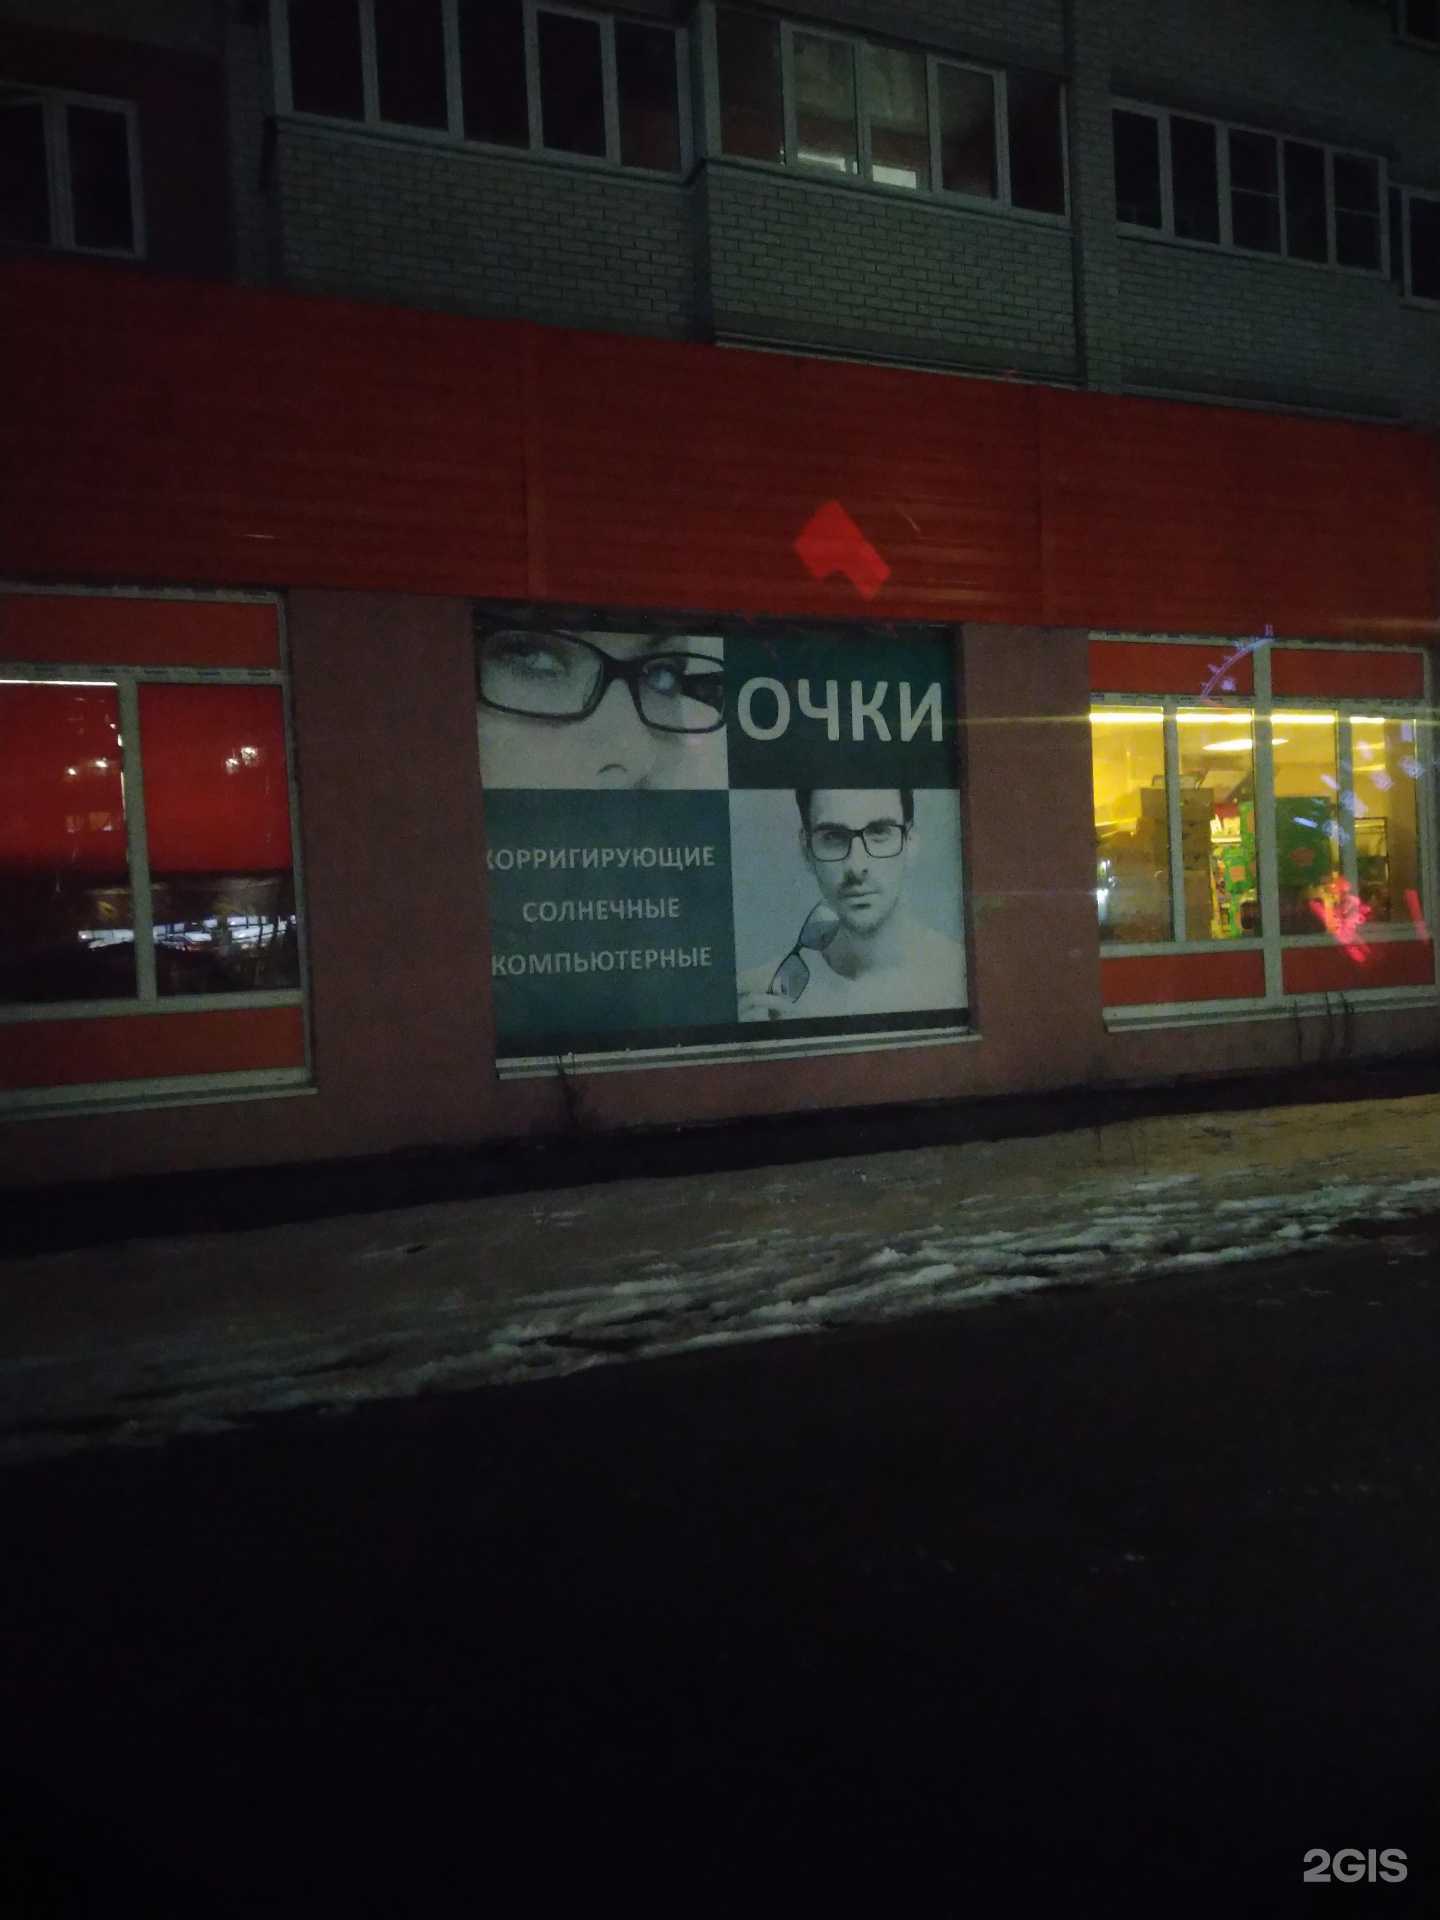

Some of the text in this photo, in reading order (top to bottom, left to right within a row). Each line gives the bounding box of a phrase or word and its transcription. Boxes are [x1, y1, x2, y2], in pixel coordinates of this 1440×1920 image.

[737, 676, 944, 743] ОЧКИ
[522, 898, 681, 923] СОЛНЕЧНЫЕ
[491, 947, 713, 976] КОМПЬЮТЕРНЫЕ
